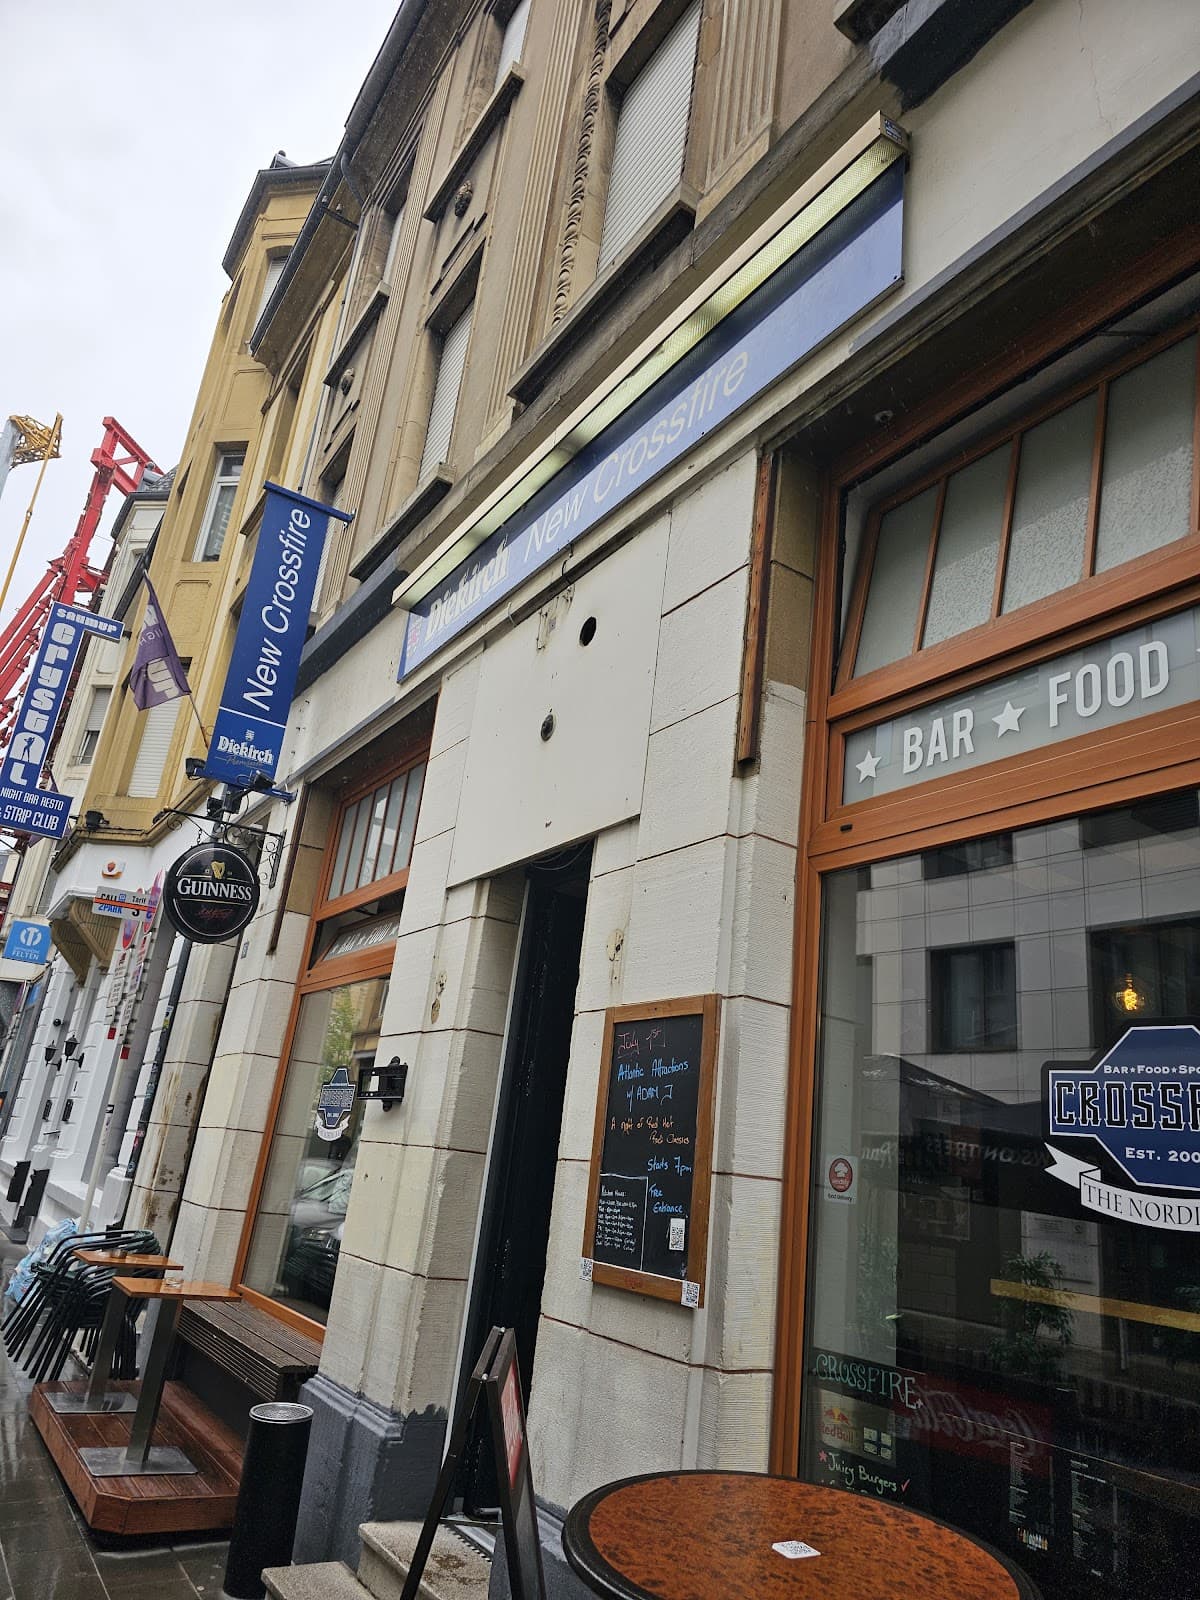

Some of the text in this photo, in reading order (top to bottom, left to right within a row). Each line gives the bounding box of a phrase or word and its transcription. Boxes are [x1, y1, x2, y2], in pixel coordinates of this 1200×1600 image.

[424, 351, 749, 642] Diekirch New Crossfire
[243, 508, 311, 711] New Crossfire
[903, 641, 1169, 774] BAR FOOD
[217, 735, 275, 765] Diekirch
[0, 787, 64, 811] NIGHT BAR RESTO
[3, 805, 32, 823] STRIP
[32, 812, 59, 830] CLUB
[177, 878, 252, 900] GUINNESS
[611, 1116, 616, 1130] A
[647, 1156, 669, 1171] Starts
[649, 1183, 663, 1197] Free
[1083, 1182, 1123, 1215] THE
[652, 1201, 683, 1213] Entrance
[816, 1353, 918, 1410] CROSSFIRE
[828, 1452, 855, 1485] Juicy
[858, 1465, 897, 1495] Burgers
